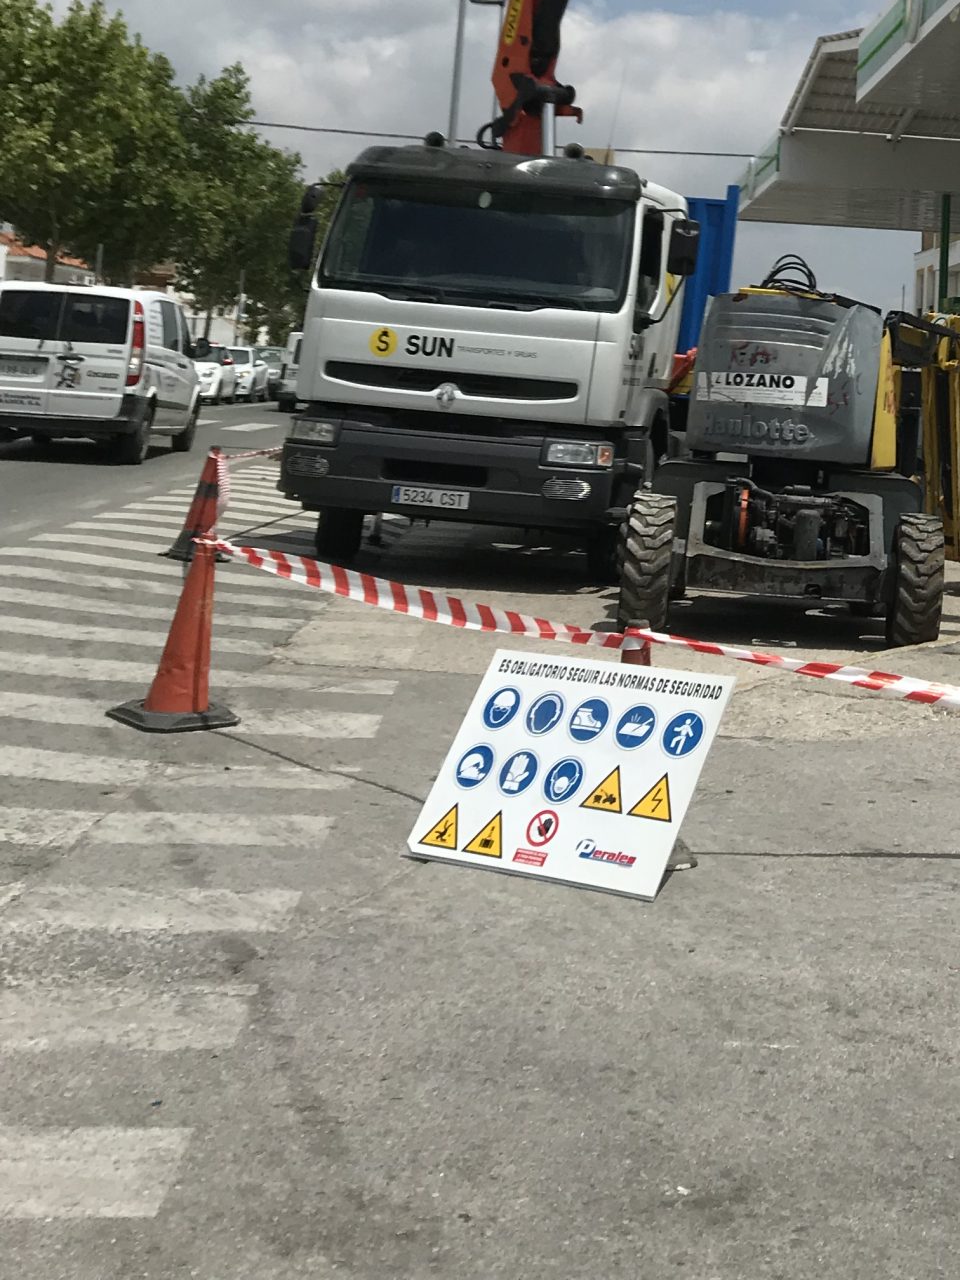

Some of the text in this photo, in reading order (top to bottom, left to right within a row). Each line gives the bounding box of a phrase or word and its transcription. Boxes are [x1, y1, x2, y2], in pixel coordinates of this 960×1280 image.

[405, 335, 455, 357] SUN
[725, 373, 795, 389] LOZANO
[403, 488, 464, 507] 5234 CST
[498, 658, 723, 701] ES OBLIGATORIO SEGUIR LAS NORMAS DE SEGURIDAD
